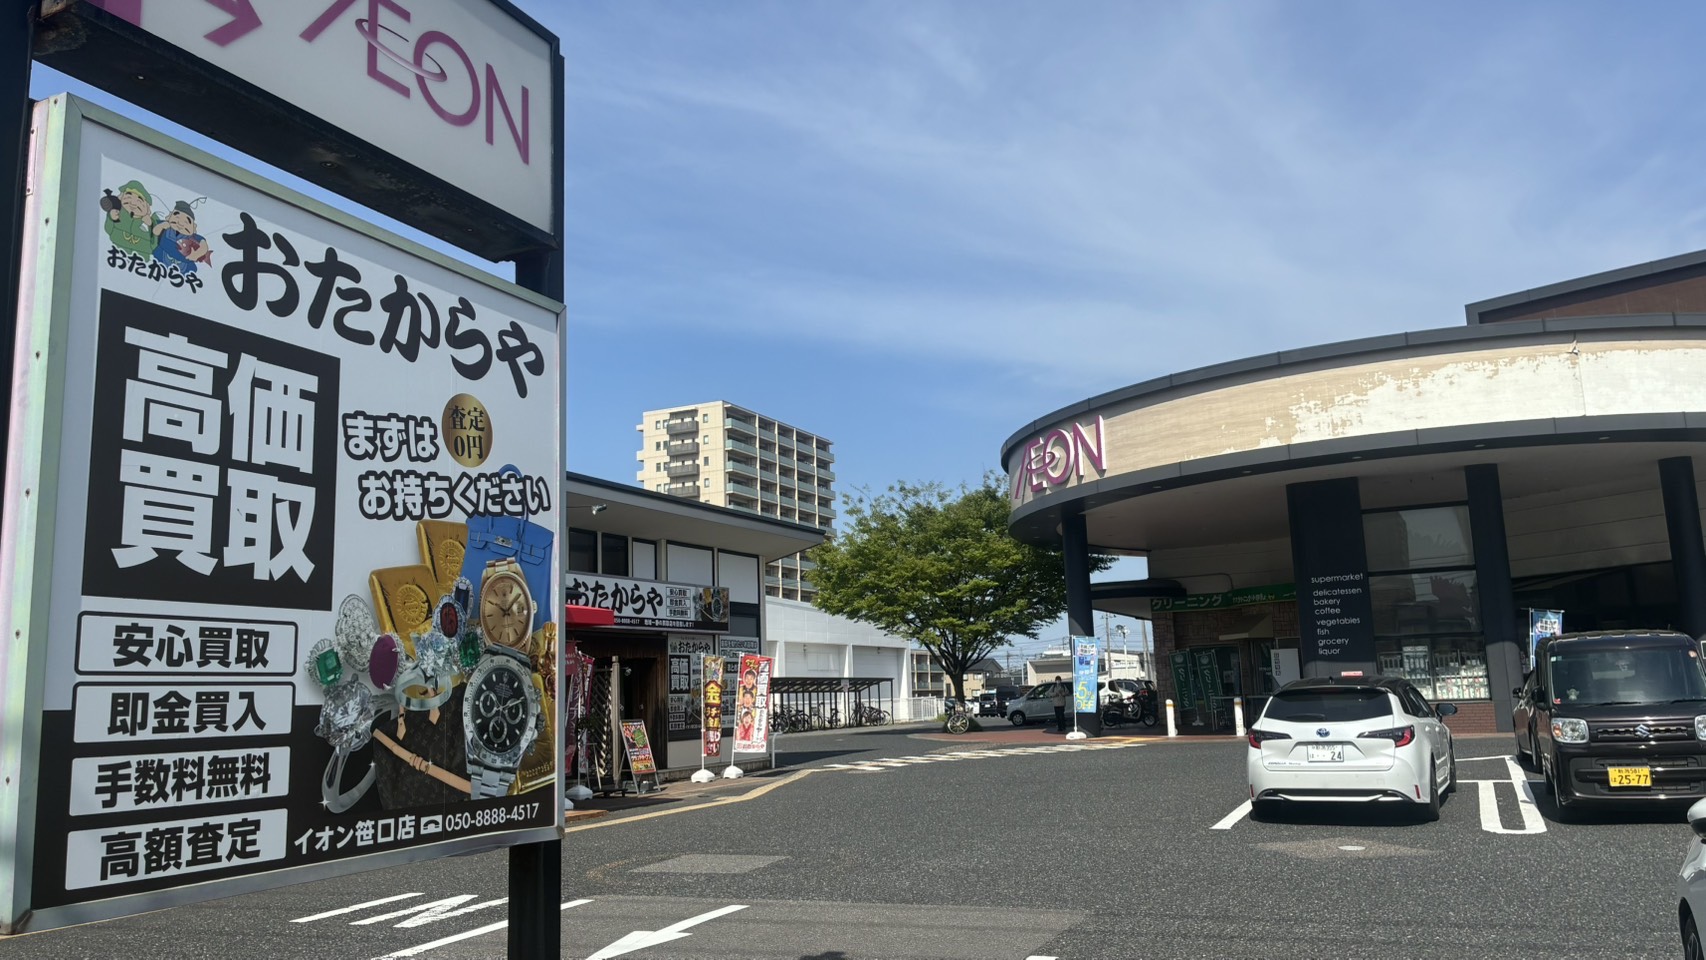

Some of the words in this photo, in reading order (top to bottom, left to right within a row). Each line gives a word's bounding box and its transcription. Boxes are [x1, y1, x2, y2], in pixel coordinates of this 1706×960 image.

[107, 245, 204, 294] おたからや
[221, 212, 545, 399] おたからや
[123, 326, 319, 474] 高価
[448, 405, 486, 432] 査定
[342, 410, 440, 463] まずは
[453, 434, 484, 460] 0円
[358, 469, 551, 521] お持ちください
[112, 449, 315, 583] 買取
[1311, 573, 1363, 584] supermarket
[1152, 594, 1222, 609] クリーニング
[1313, 588, 1362, 597] delicatessen
[1315, 607, 1341, 615] coffee
[1316, 617, 1360, 626] vegetables
[112, 622, 271, 671] 安心買取
[1318, 638, 1349, 646] grocery
[1319, 648, 1340, 656] liquor
[705, 683, 721, 703] 金
[1075, 700, 1094, 710] OFF
[106, 690, 267, 736] 即金買入
[94, 753, 271, 807] 手数料無料
[1618, 774, 1648, 784] 25-77
[294, 814, 415, 854] イオン笹口店
[446, 803, 539, 831] 050-8888-4517
[100, 818, 261, 881] 高額査定
